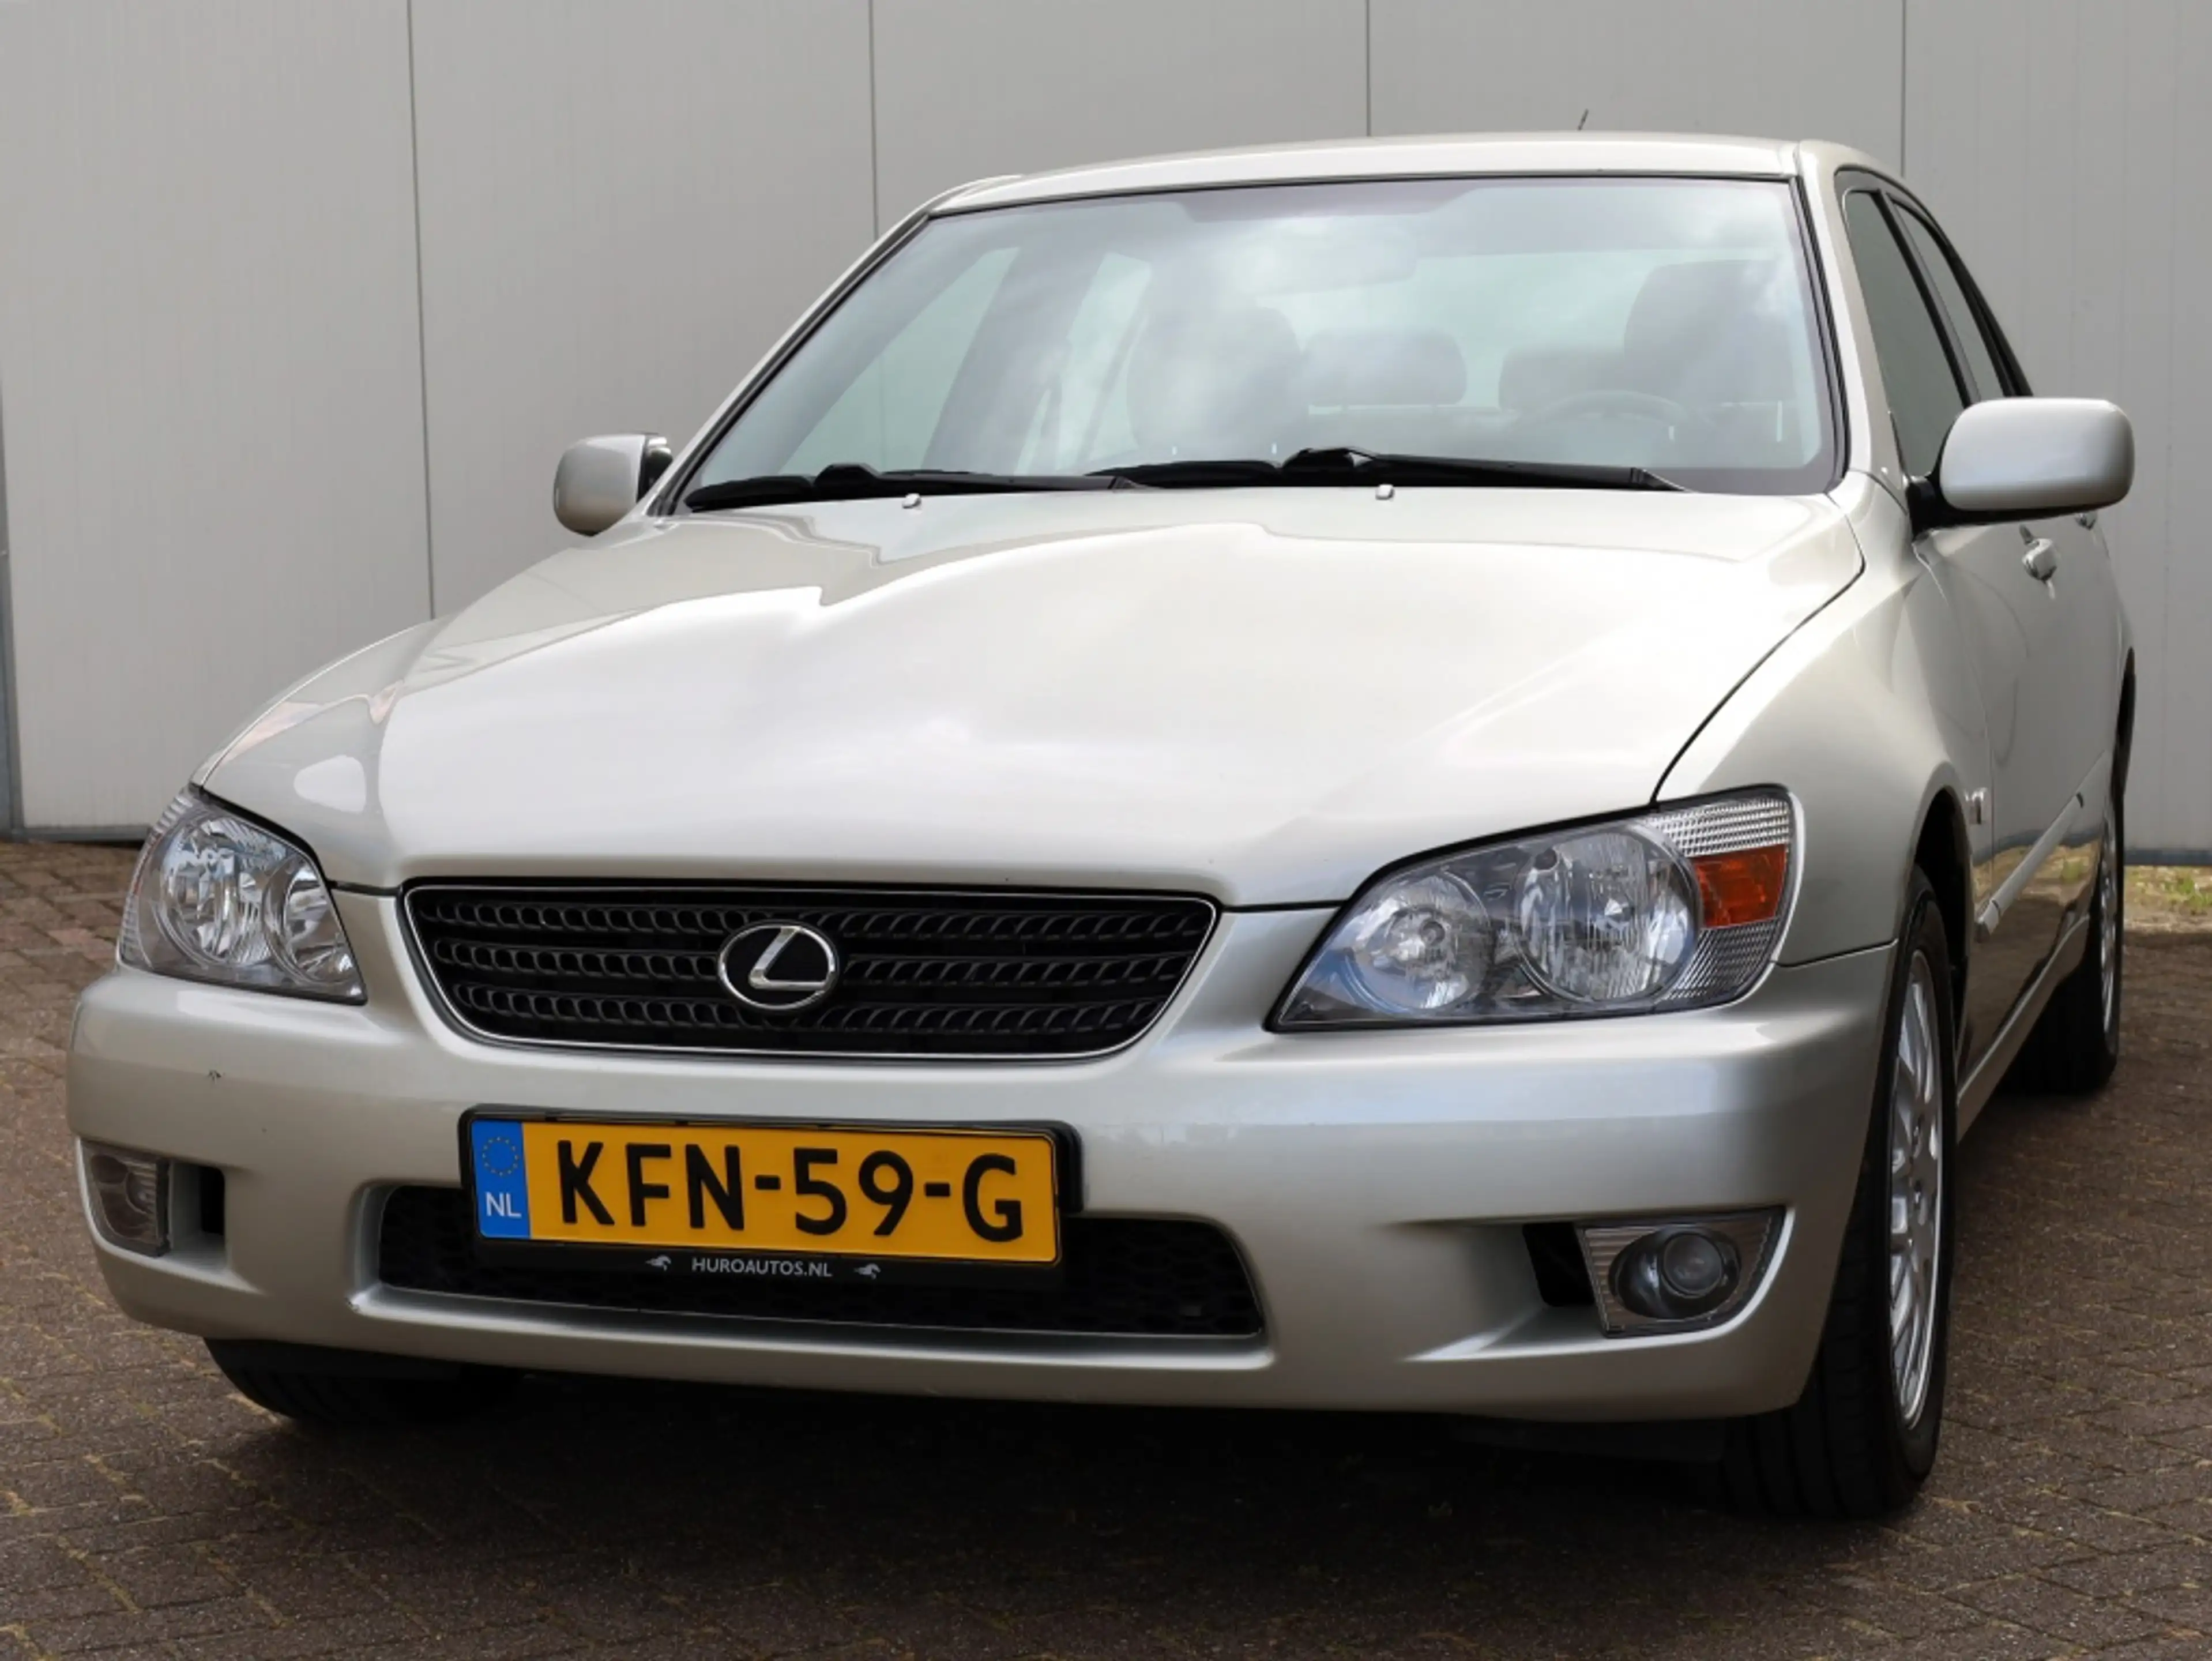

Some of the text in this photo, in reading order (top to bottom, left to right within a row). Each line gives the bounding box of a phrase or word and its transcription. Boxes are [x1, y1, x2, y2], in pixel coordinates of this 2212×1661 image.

[556, 1139, 1024, 1244] KFN-59-G
[486, 1192, 522, 1218] NL
[691, 1257, 833, 1277] HUROAUTOS.NL
